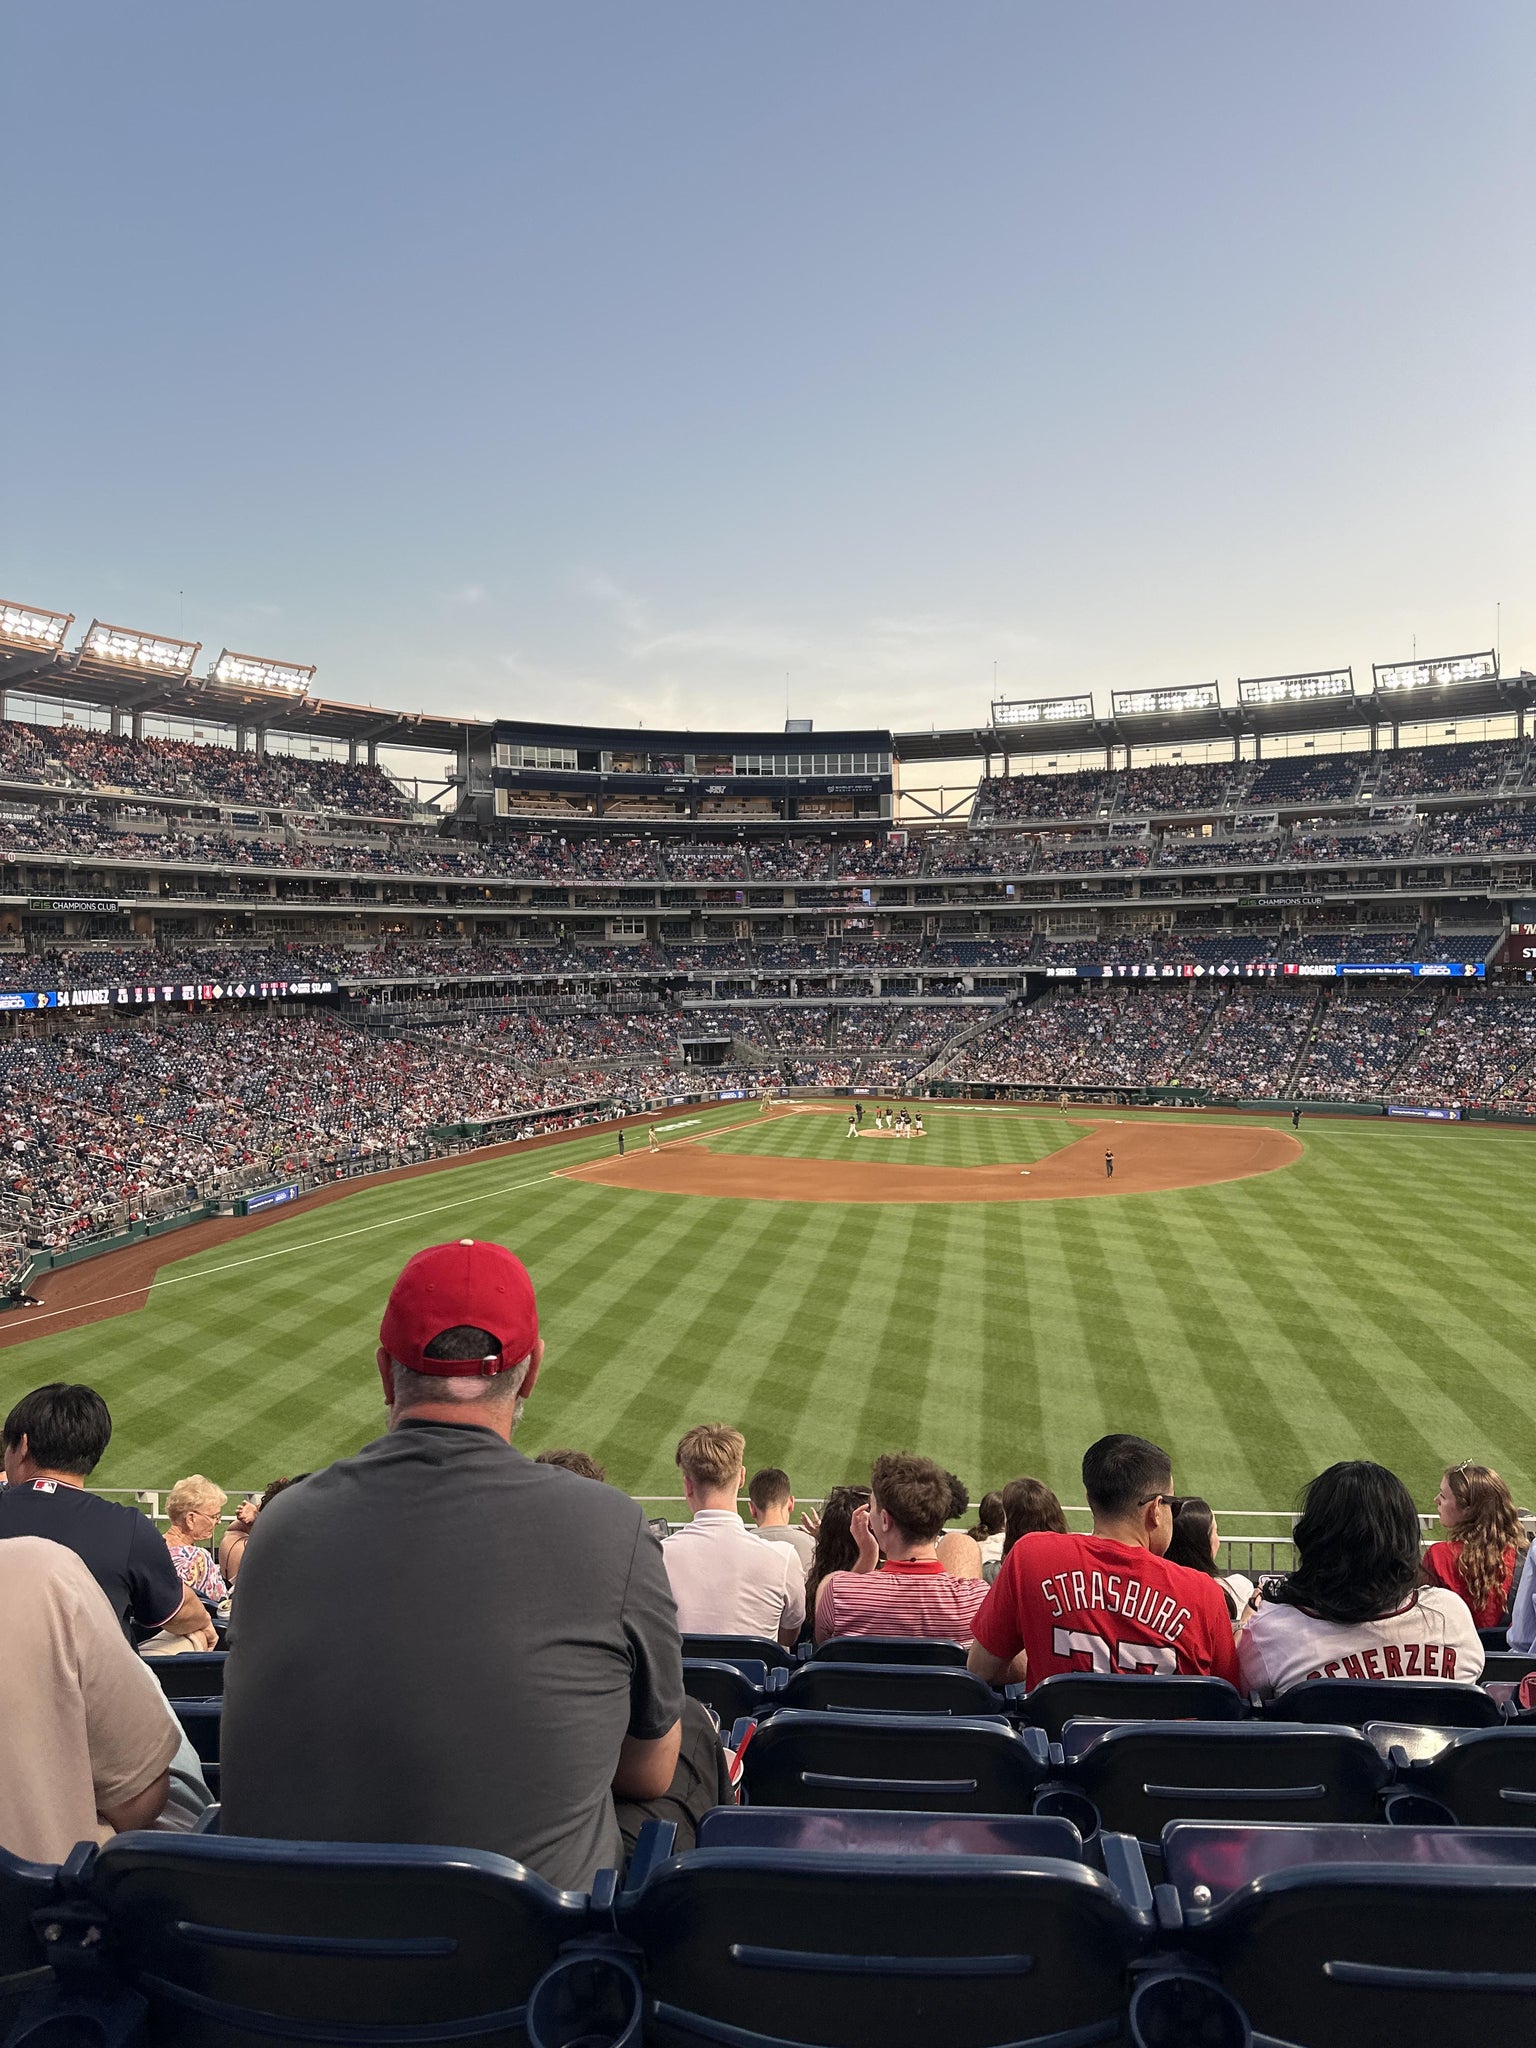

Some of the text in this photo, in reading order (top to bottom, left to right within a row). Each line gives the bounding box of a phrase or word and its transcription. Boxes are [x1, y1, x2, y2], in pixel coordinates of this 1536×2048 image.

[52, 901, 96, 911] CHAMPIONS
[97, 903, 117, 911] CLUB
[1298, 964, 1337, 976] BOGAERTS
[57, 991, 70, 1007] 54
[72, 989, 110, 1006] ALVAREZ
[226, 985, 233, 997] 4
[249, 984, 256, 996] 4
[1041, 1570, 1191, 1642] STRASBURG
